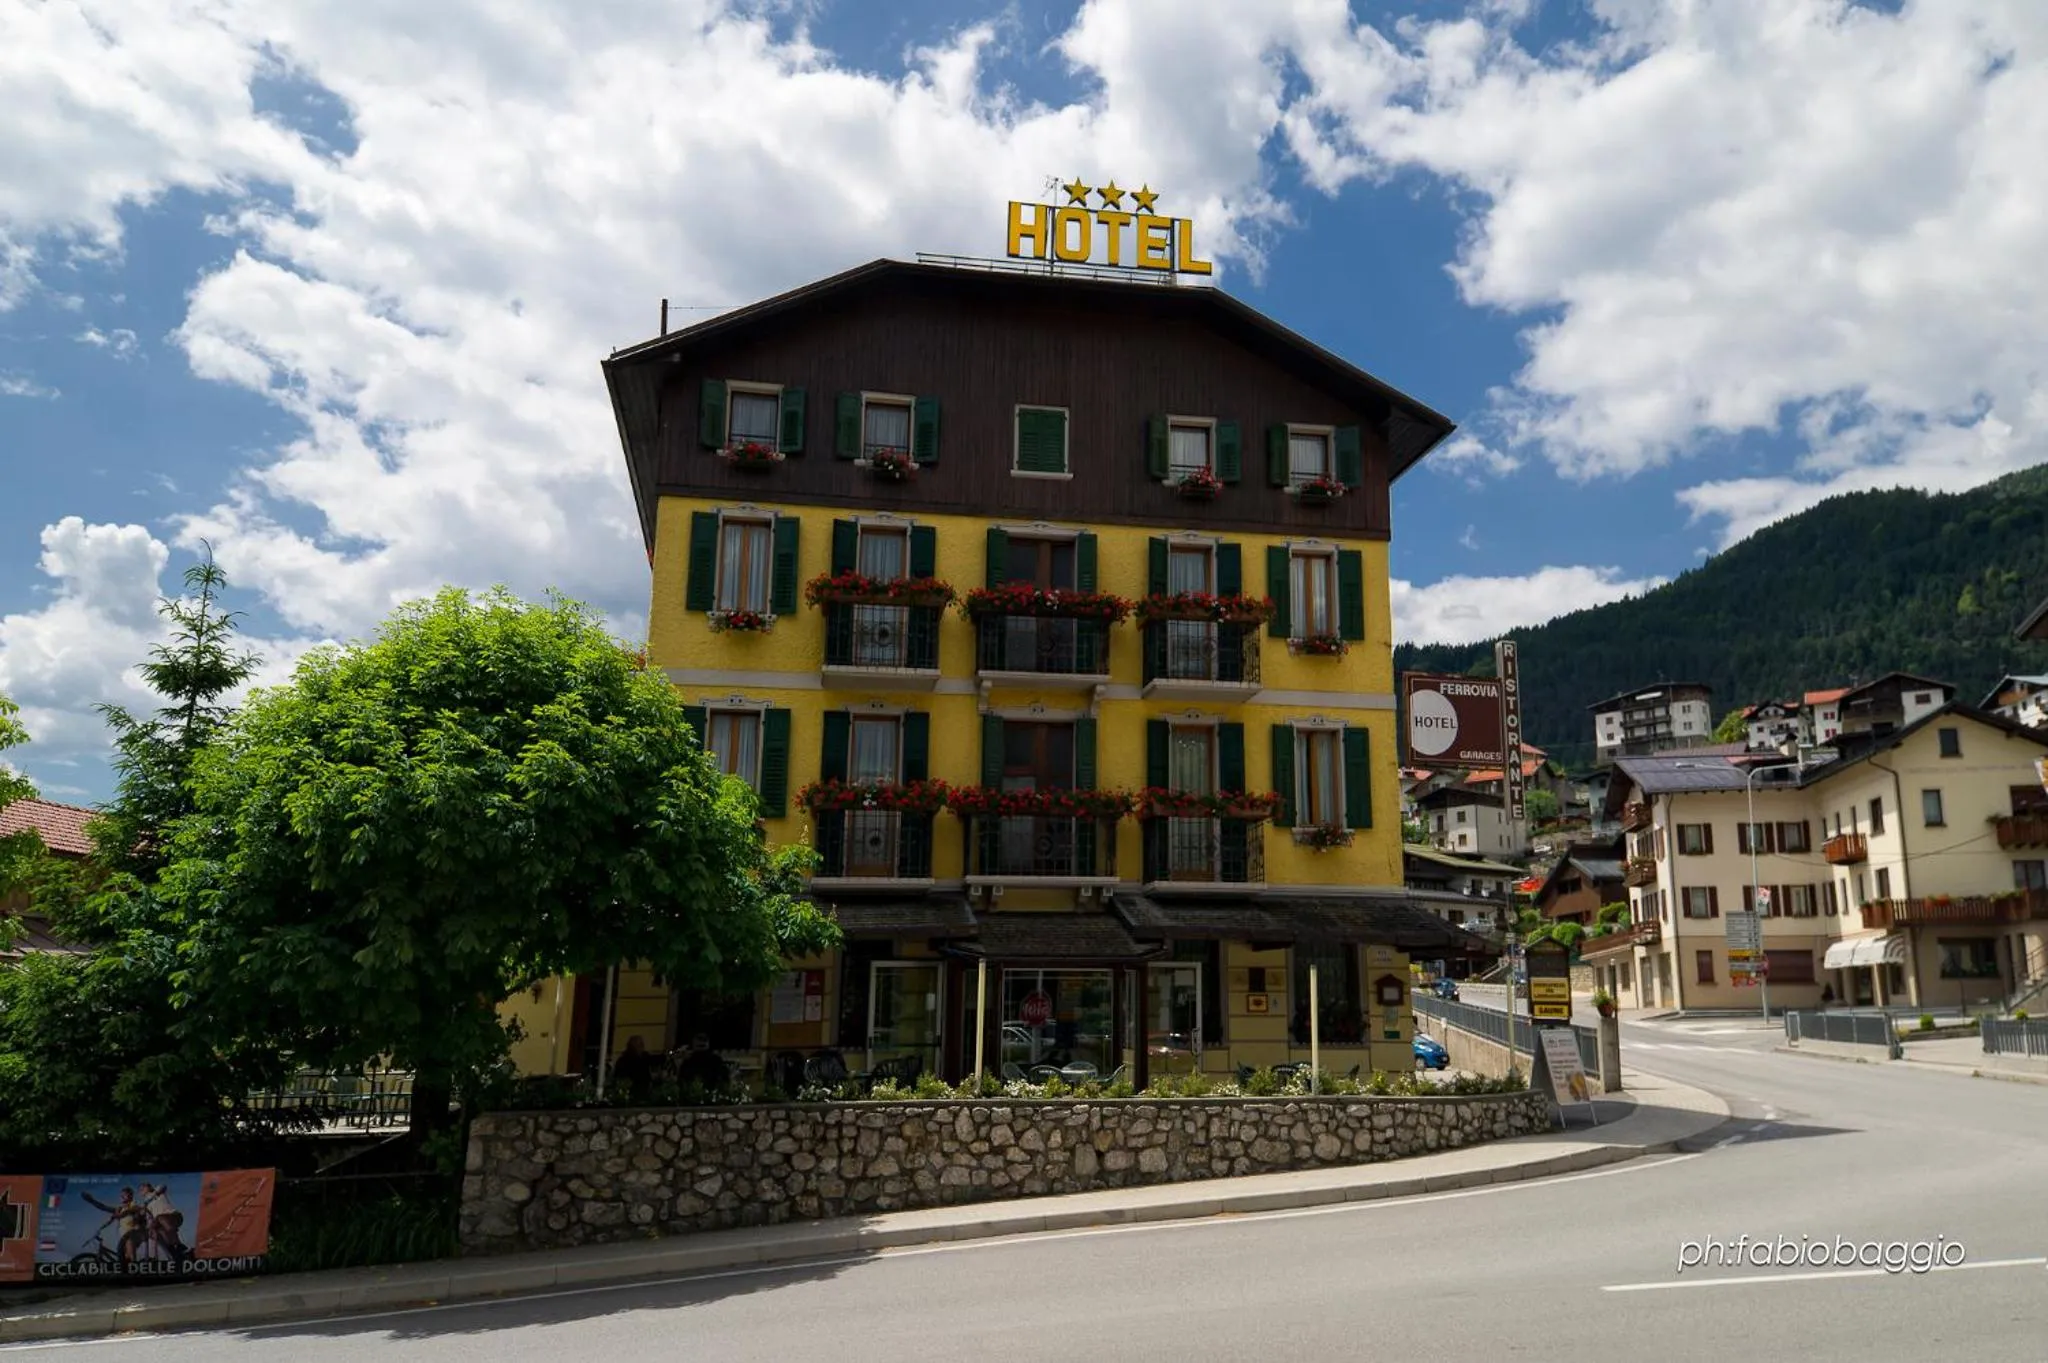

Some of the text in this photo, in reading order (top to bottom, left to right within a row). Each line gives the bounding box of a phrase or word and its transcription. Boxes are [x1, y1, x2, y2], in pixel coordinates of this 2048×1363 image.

[1007, 201, 1212, 275] HOTEL
[1440, 683, 1498, 698] FERROVIA
[1415, 716, 1457, 729] HOTEL
[1503, 644, 1524, 818] RISTORANTE
[1459, 751, 1502, 761] GARAGES
[38, 1255, 263, 1277] CICLABILE DELLE DOLOMITI
